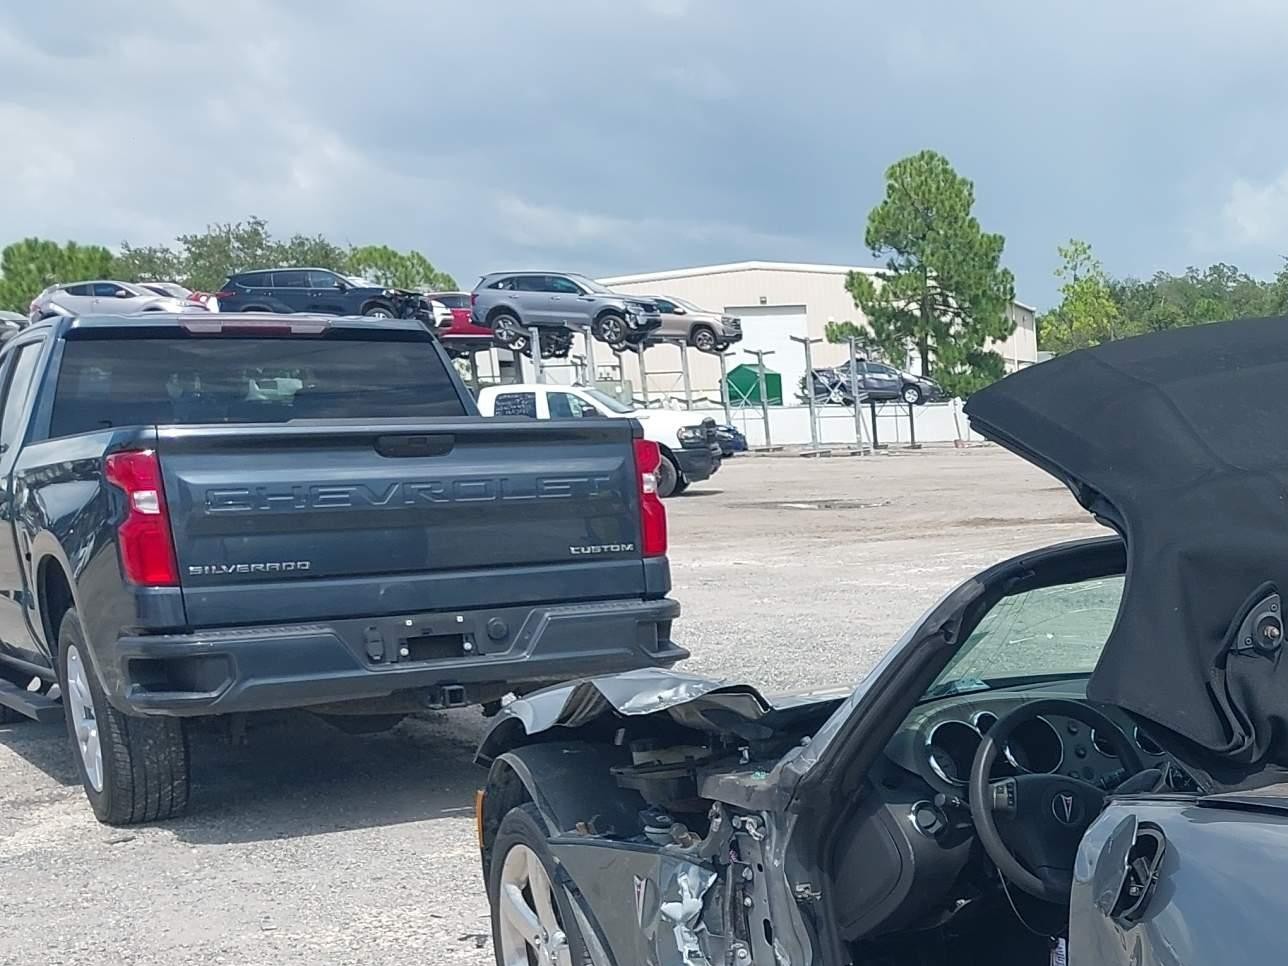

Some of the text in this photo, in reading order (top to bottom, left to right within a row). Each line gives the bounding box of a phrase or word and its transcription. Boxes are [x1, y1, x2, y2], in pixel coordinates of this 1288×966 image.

[205, 476, 611, 514] CHEVROLET
[569, 543, 635, 555] CUSTOM
[188, 560, 311, 575] SILVERADO
